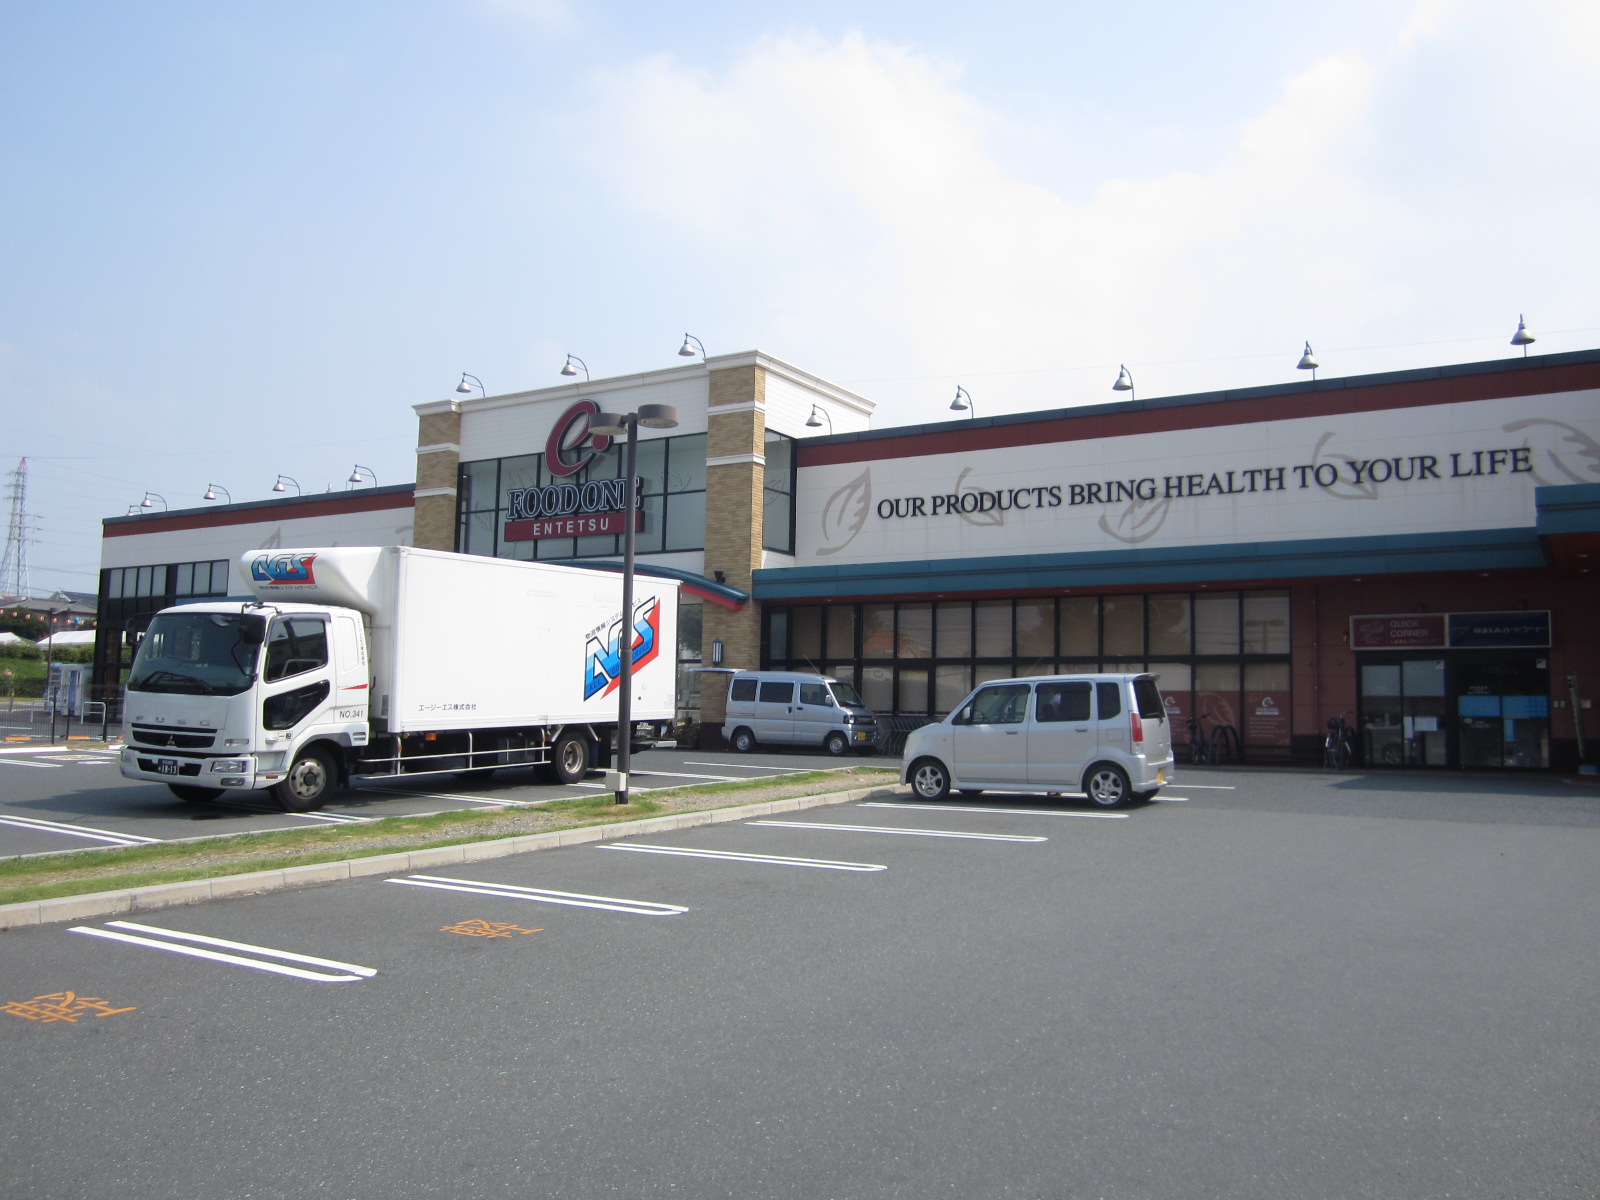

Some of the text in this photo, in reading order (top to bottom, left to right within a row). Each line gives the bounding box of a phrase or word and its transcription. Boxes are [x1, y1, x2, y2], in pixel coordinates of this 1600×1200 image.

[877, 447, 1533, 519] OUR PRODUCTS BRING HEALTH TO YOUR LIFE
[533, 518, 609, 535] ENTETSU
[1389, 620, 1419, 629] QUICK
[1389, 629, 1429, 638] CORNER
[418, 703, 477, 712] エージーエス株式会社
[339, 709, 364, 718] NO.341
